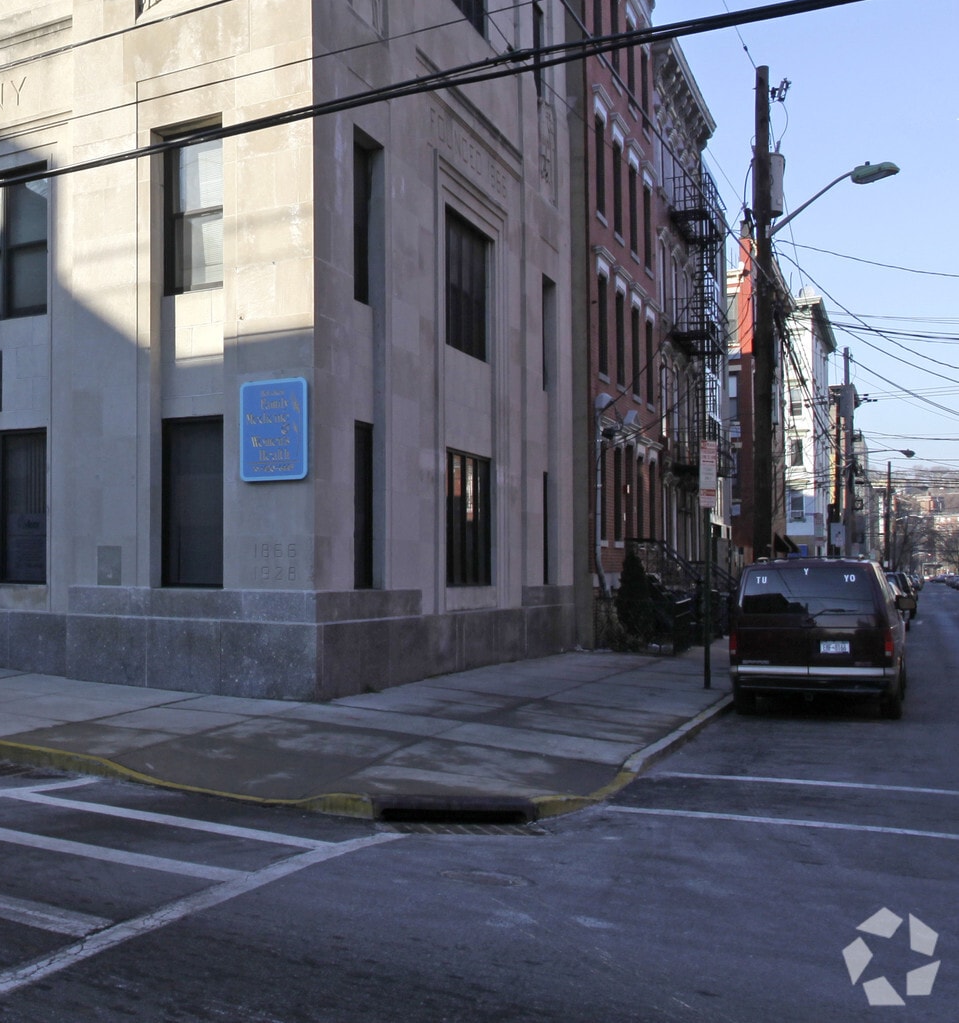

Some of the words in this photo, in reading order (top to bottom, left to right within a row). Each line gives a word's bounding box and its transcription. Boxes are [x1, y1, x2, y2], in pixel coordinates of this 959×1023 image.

[254, 543, 296, 558] 1866
[254, 566, 296, 581] 1928
[756, 576, 767, 584] TU
[803, 568, 809, 576] Y
[844, 574, 856, 582] YO
